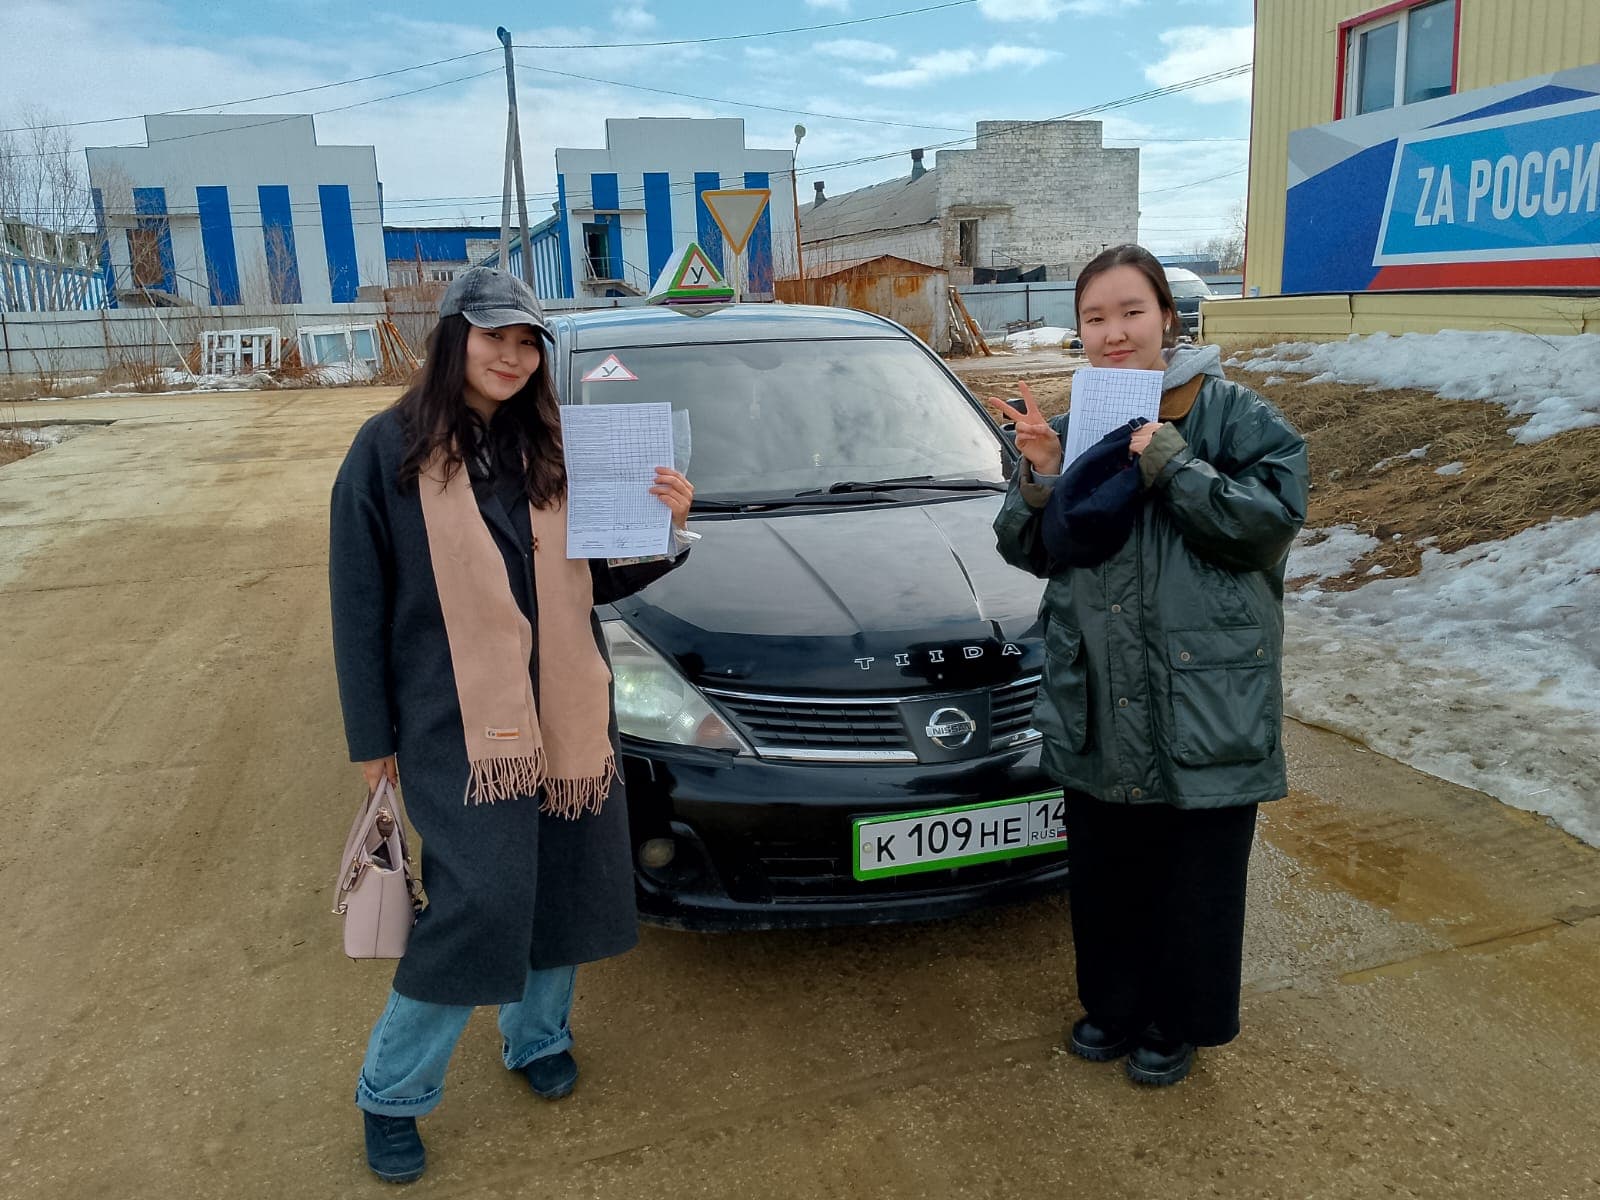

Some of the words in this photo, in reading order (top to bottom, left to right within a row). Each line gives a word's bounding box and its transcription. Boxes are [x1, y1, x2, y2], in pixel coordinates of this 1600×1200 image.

[854, 643, 1023, 671] TIIDA
[932, 721, 971, 736] NISSAN
[1031, 828, 1056, 841] RUS
